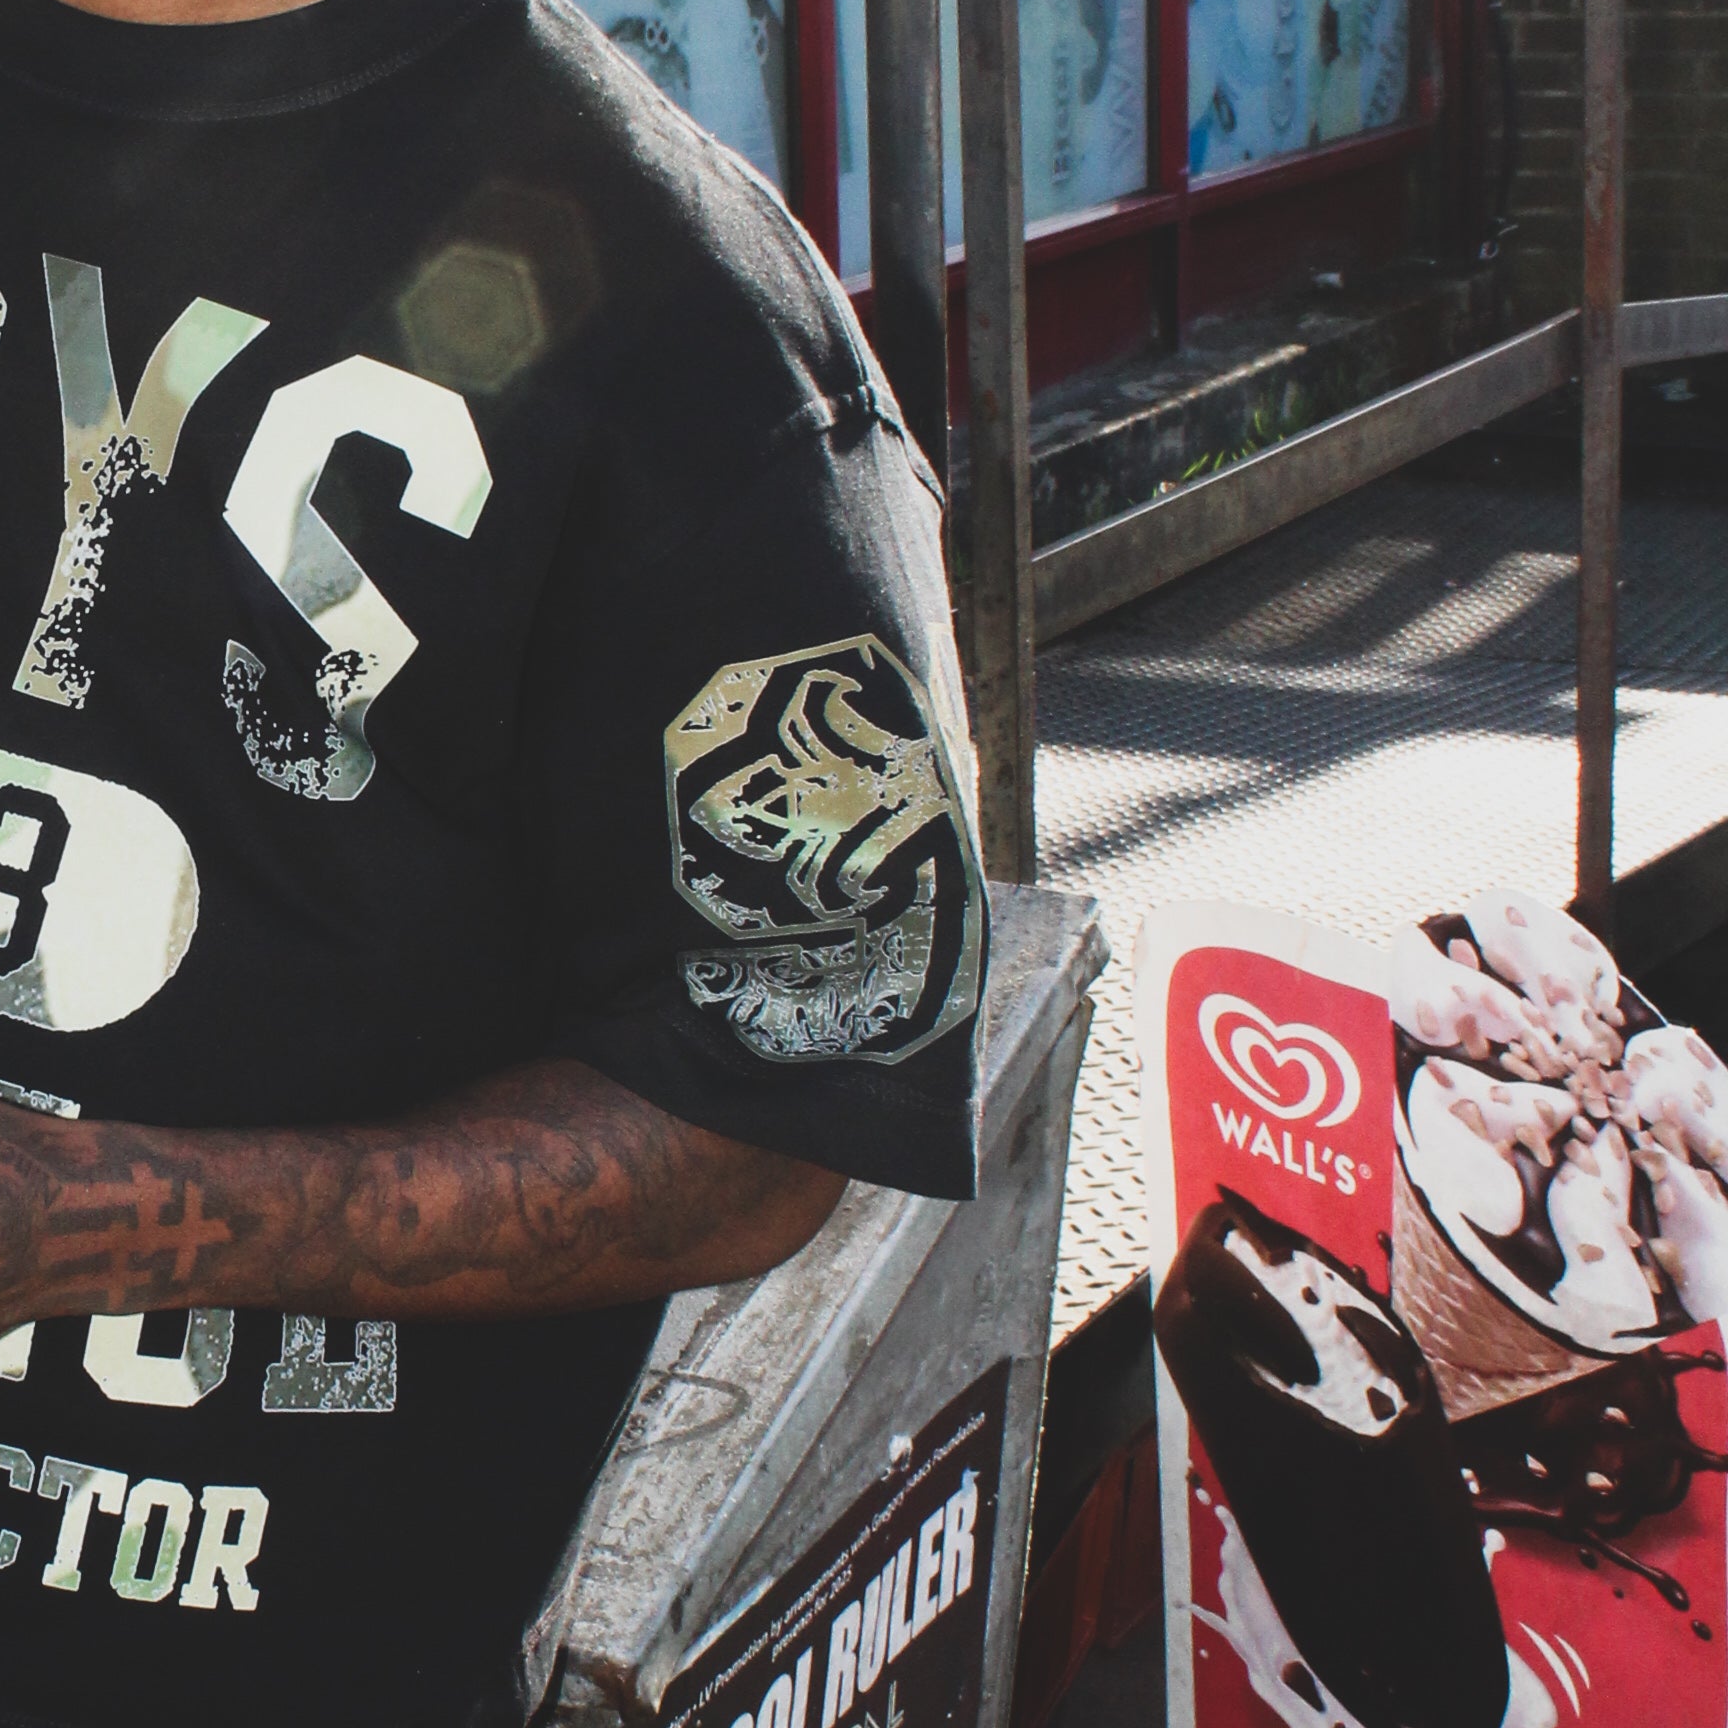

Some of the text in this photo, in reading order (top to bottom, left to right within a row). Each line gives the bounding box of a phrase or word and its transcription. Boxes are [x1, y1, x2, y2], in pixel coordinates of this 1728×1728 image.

[1212, 1101, 1358, 1197] WALL'S
[698, 1681, 714, 1708] LV
[714, 1631, 769, 1694] Promotion
